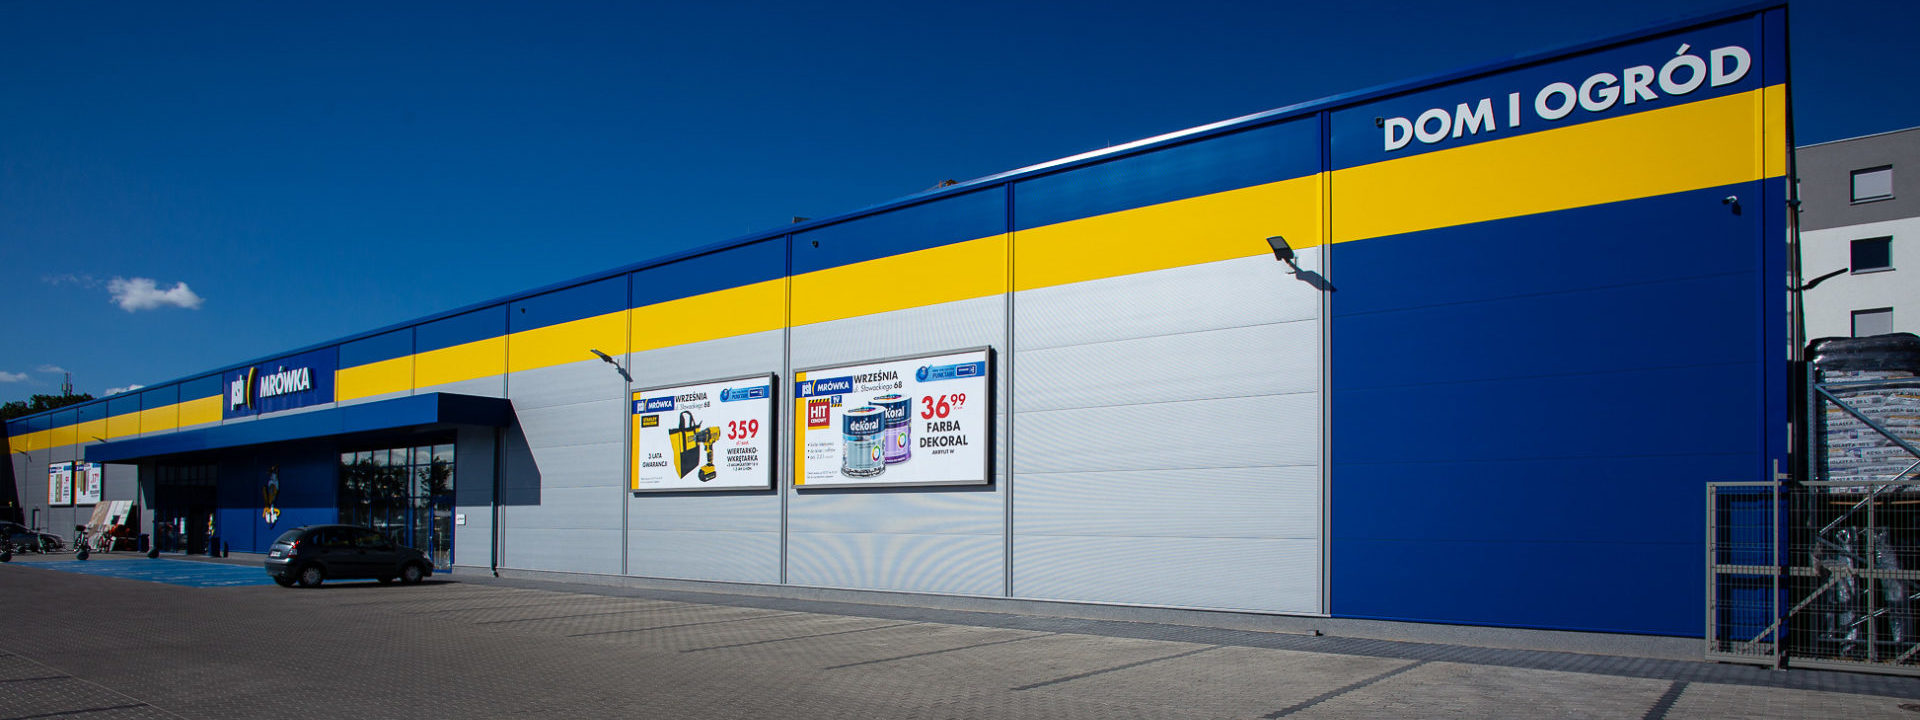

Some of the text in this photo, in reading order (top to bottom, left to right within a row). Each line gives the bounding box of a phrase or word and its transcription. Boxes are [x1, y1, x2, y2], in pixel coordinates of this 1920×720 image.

[1384, 43, 1752, 152] DOM I OGRÓD
[260, 365, 310, 398] MRÓWKA
[853, 369, 898, 384] WRZEŚNIA
[817, 381, 850, 392] MRÓWKA
[893, 380, 903, 389] 68
[674, 390, 708, 403] WRZEŚNIA
[648, 400, 673, 409] MRÓWKA
[920, 393, 966, 420] 36 99
[810, 405, 828, 418] HIT
[727, 418, 759, 440] 359
[850, 417, 879, 431] dekoral
[926, 420, 961, 433] FARBA
[919, 434, 969, 448] DEKORAL
[726, 446, 759, 455] WIERTARKO-
[726, 454, 759, 464] WKRĘTARKA
